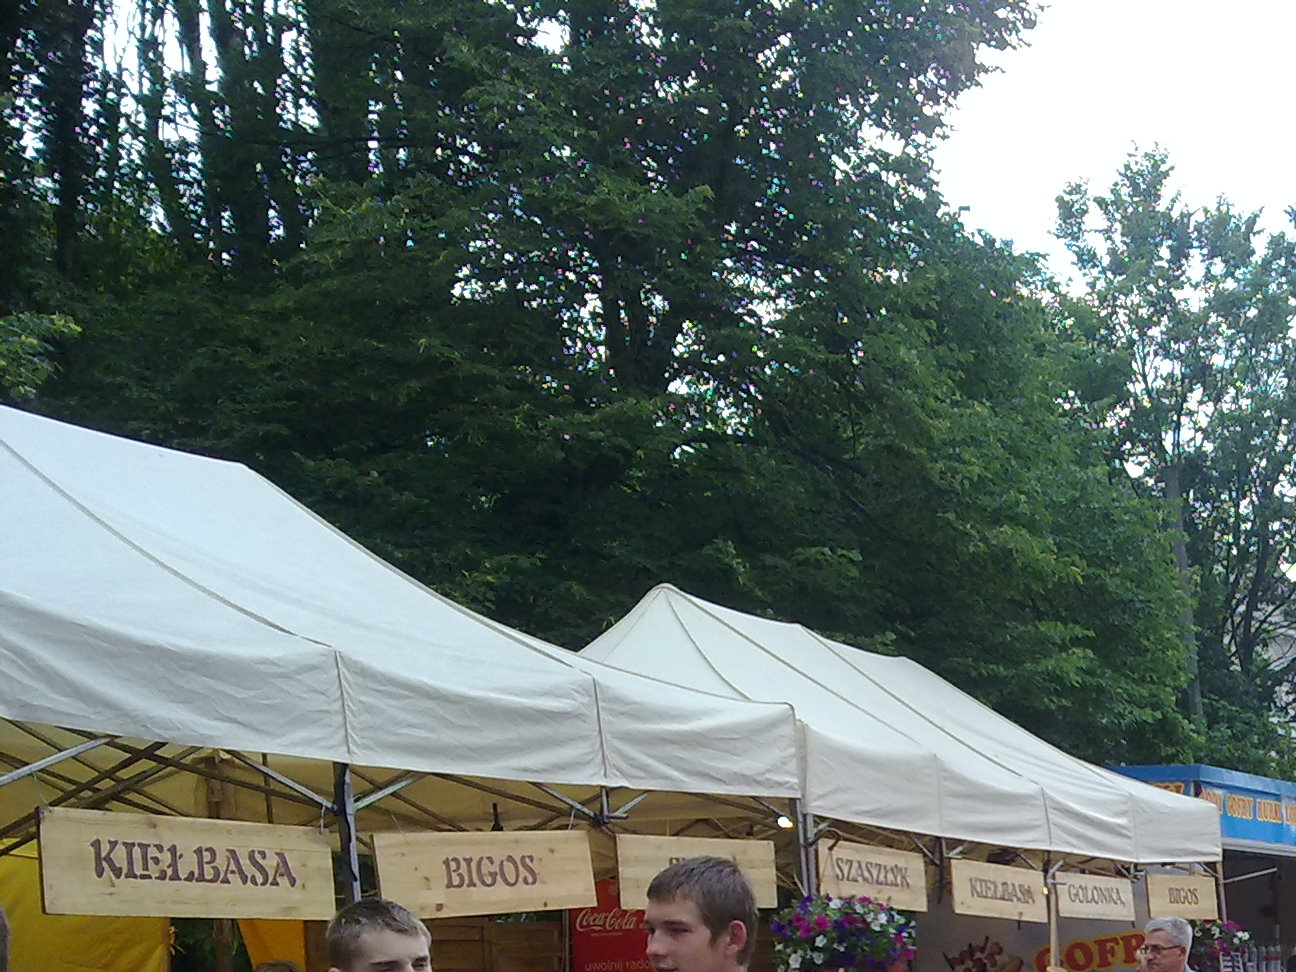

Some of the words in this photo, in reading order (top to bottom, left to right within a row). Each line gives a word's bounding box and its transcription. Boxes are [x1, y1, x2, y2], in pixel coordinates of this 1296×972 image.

[90, 838, 297, 889] KIEŁBASA
[442, 854, 538, 888] BIGOS
[1168, 886, 1200, 905] BIGOS
[575, 908, 638, 932] Coca-Cola
